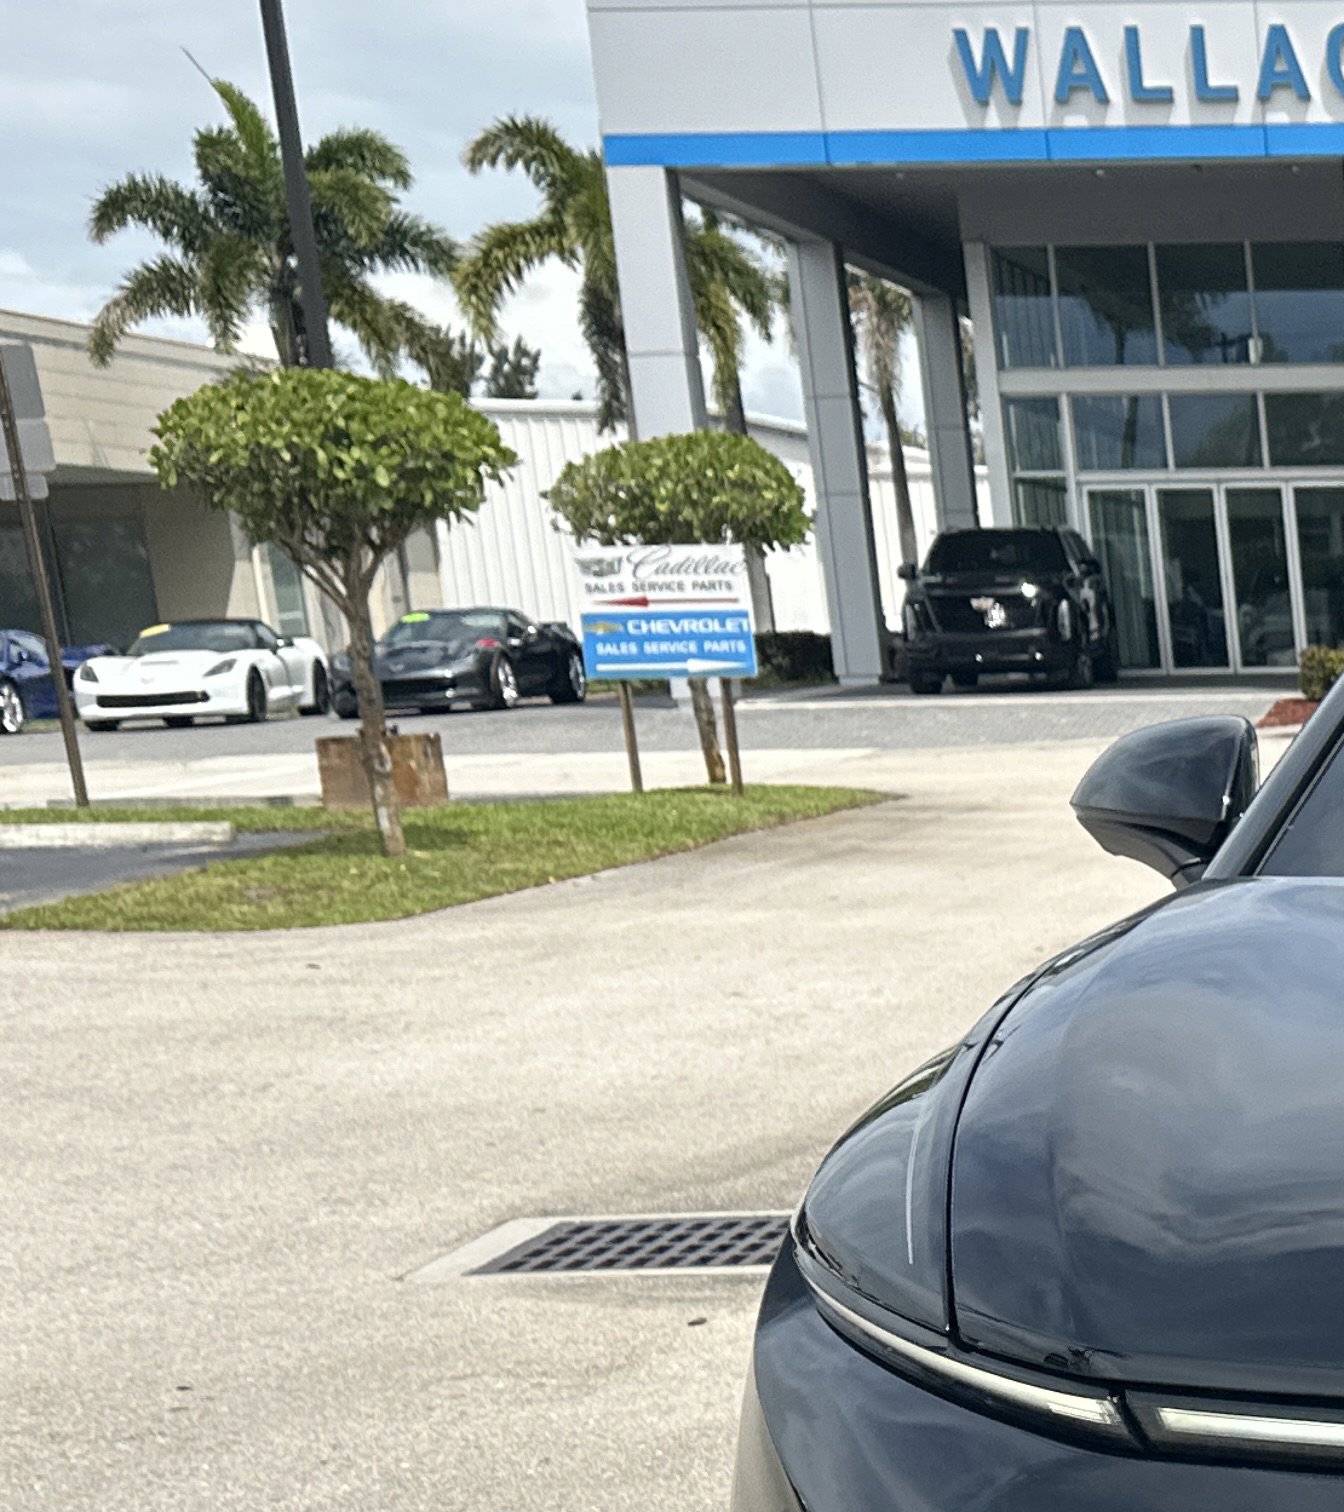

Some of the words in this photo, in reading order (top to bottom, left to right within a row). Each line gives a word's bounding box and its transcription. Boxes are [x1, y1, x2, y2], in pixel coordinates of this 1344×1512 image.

[626, 545, 746, 580] Cadillac
[585, 583, 625, 594] SALES
[632, 581, 685, 593] SERVICE
[692, 580, 733, 592] PARTS
[627, 617, 748, 635] CHEVROLET
[596, 642, 638, 656] SALES
[643, 641, 697, 655] SERVICE
[703, 640, 747, 653] PARTS
